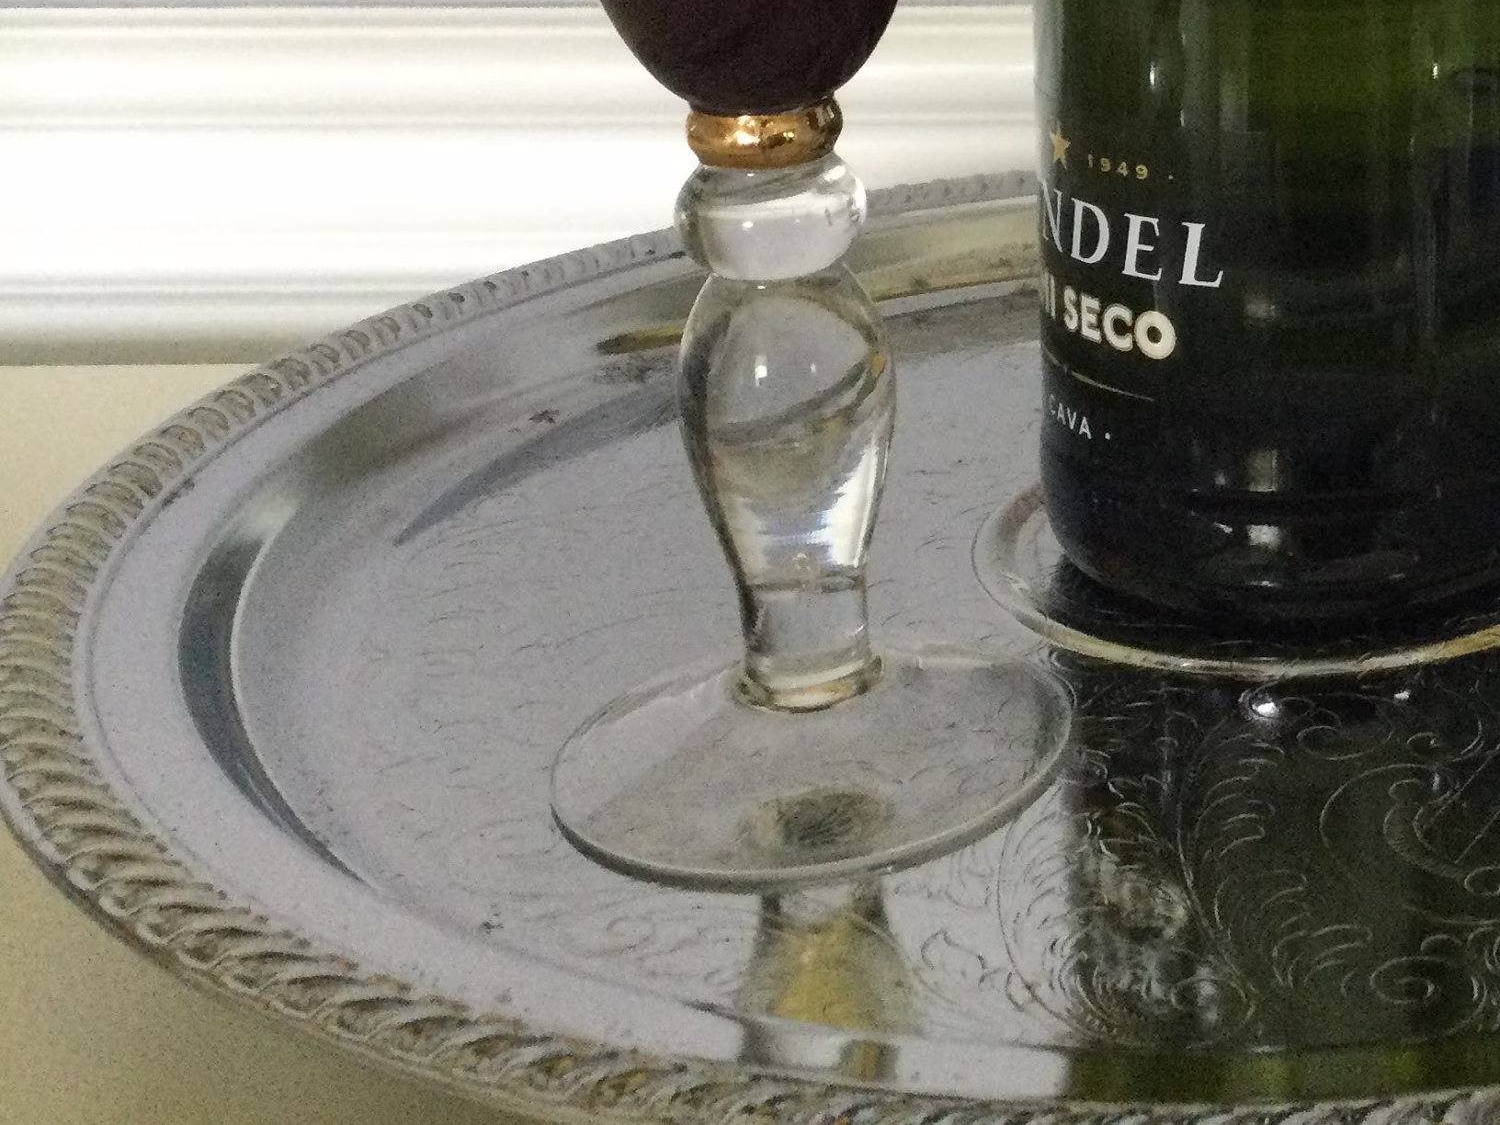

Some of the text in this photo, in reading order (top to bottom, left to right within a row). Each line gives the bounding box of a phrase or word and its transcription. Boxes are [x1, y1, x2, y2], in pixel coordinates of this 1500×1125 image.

[1087, 153, 1149, 180] 1949
[1042, 178, 1224, 289] NDEL
[1063, 285, 1178, 361] SECO
